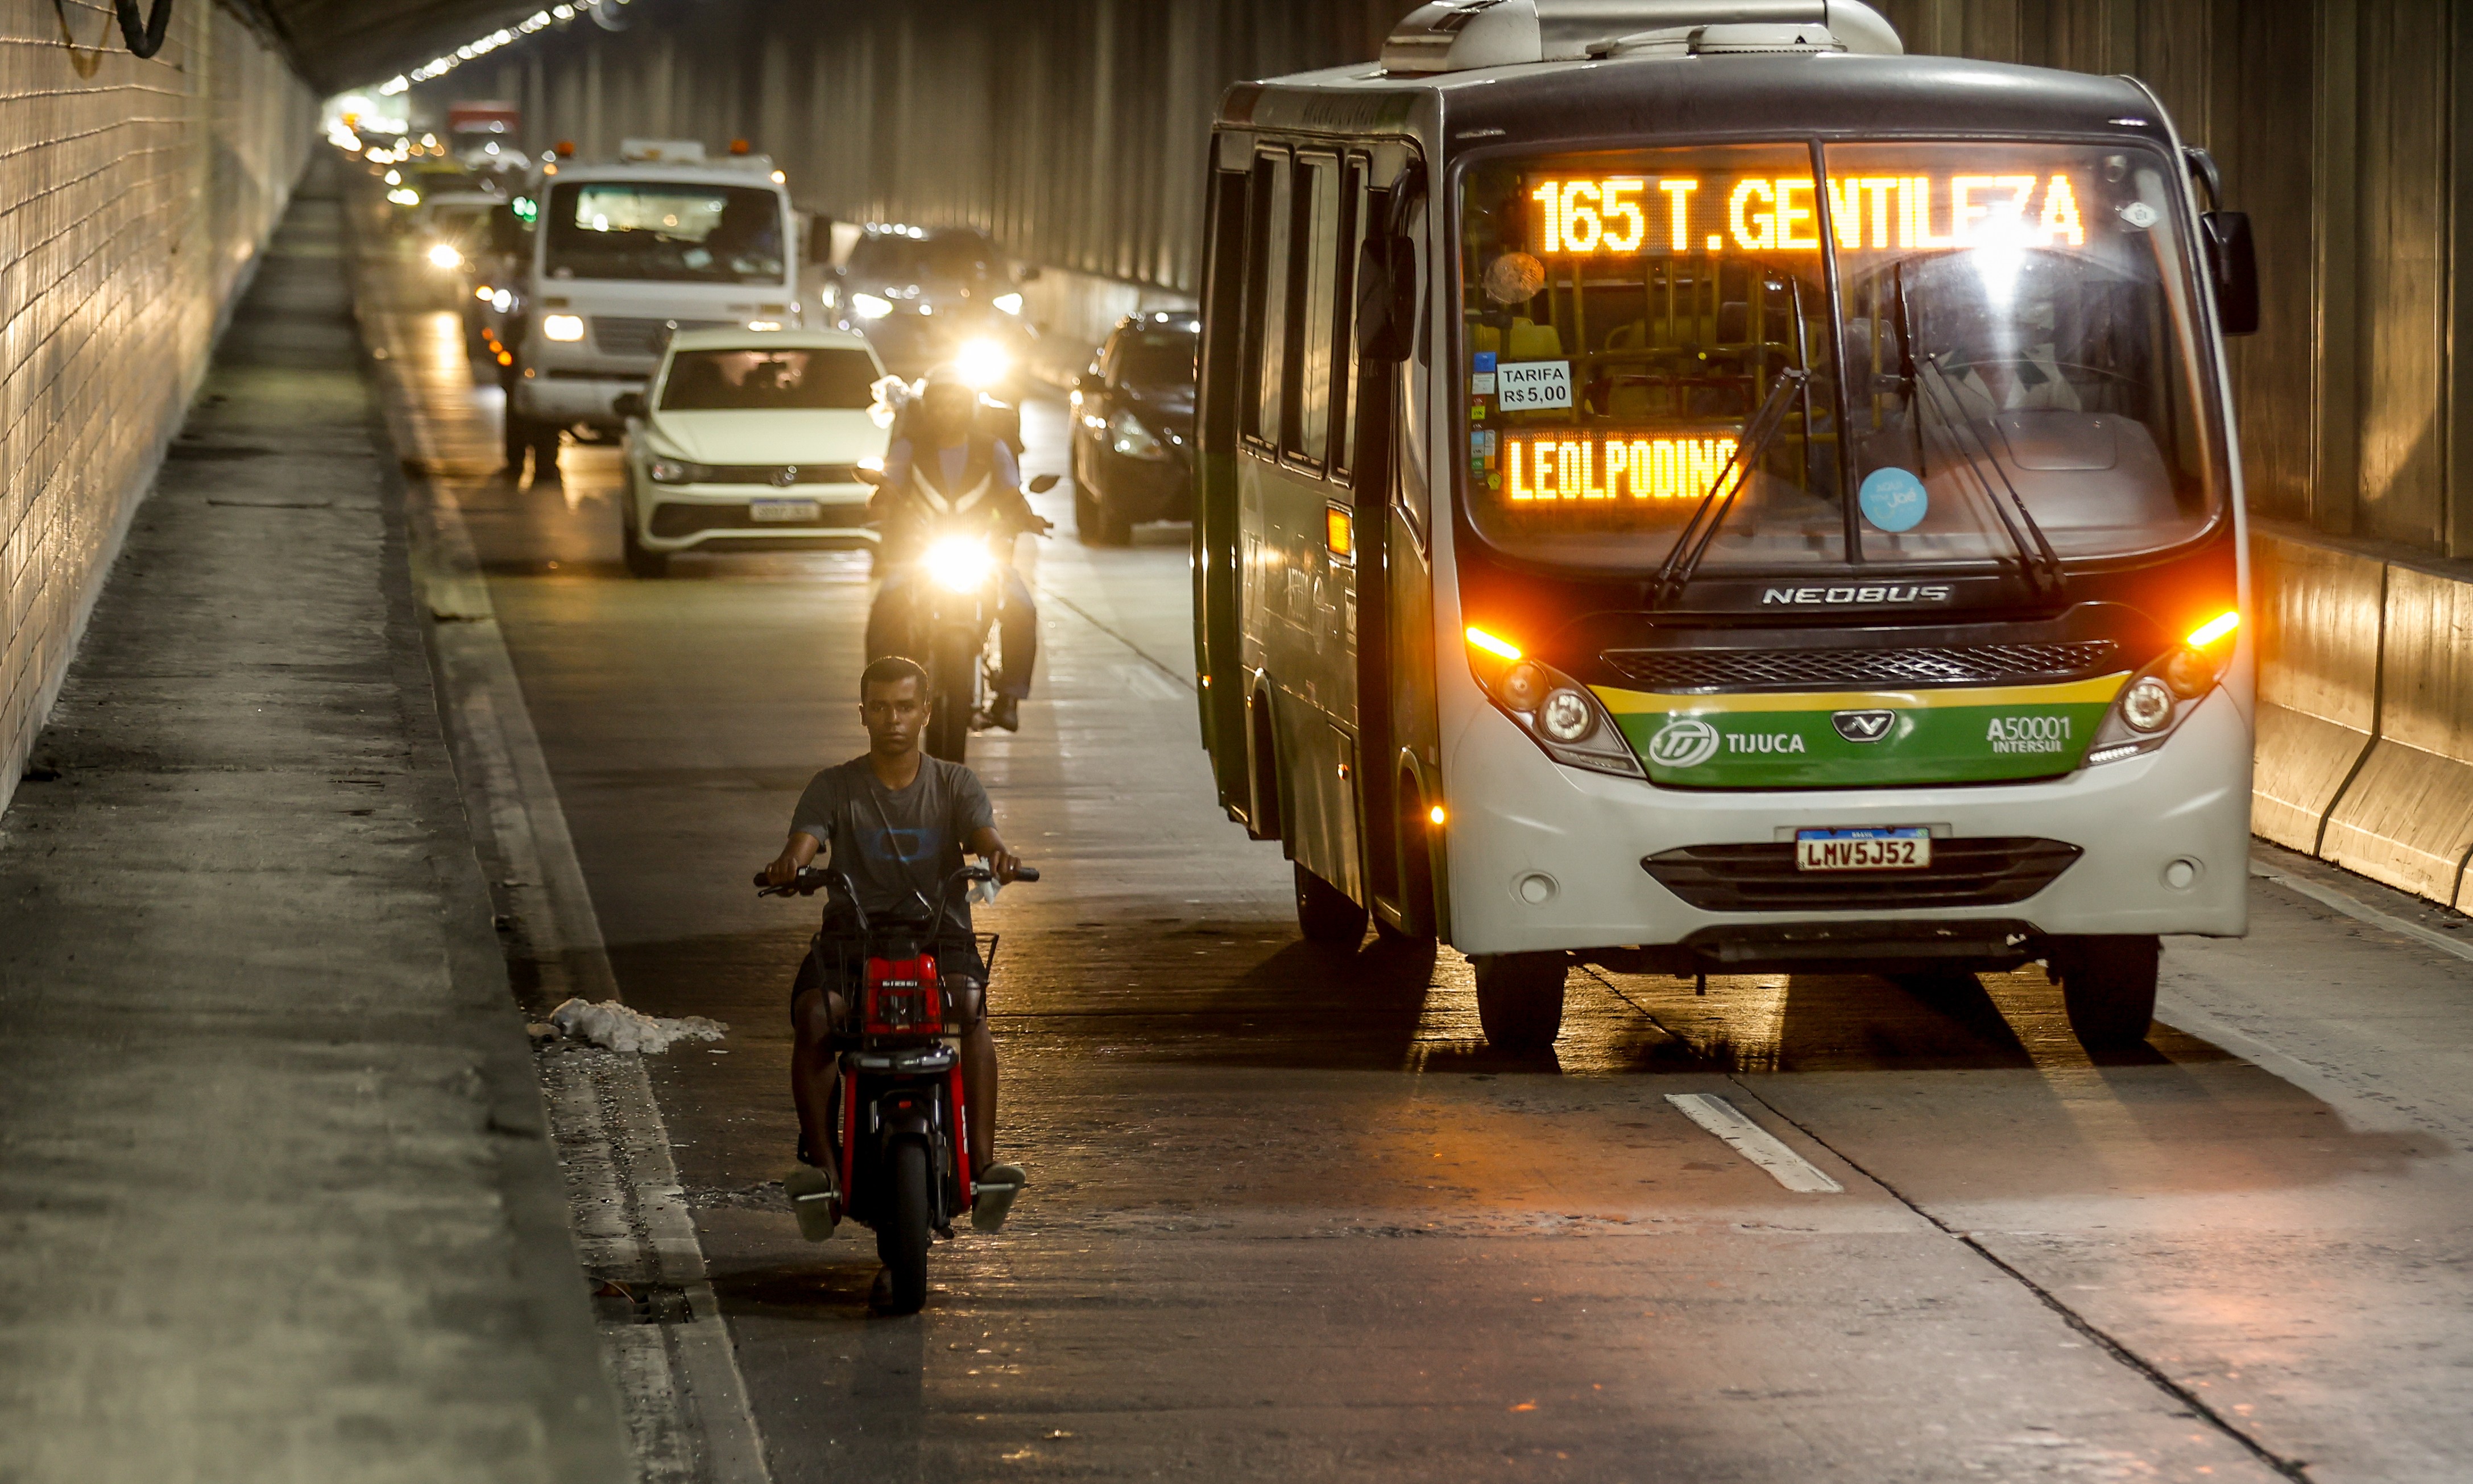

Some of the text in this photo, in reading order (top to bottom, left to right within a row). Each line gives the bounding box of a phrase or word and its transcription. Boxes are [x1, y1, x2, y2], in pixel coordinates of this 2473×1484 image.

[1532, 180, 1644, 252] 165
[1503, 368, 1564, 383] TARIFA
[1527, 385, 1566, 403] 5,00
[1762, 586, 1950, 604] NEOBUS
[1986, 716, 2070, 741] A50001
[1726, 733, 1805, 753] TIJUCA
[1807, 841, 1915, 867] LMV5J52
